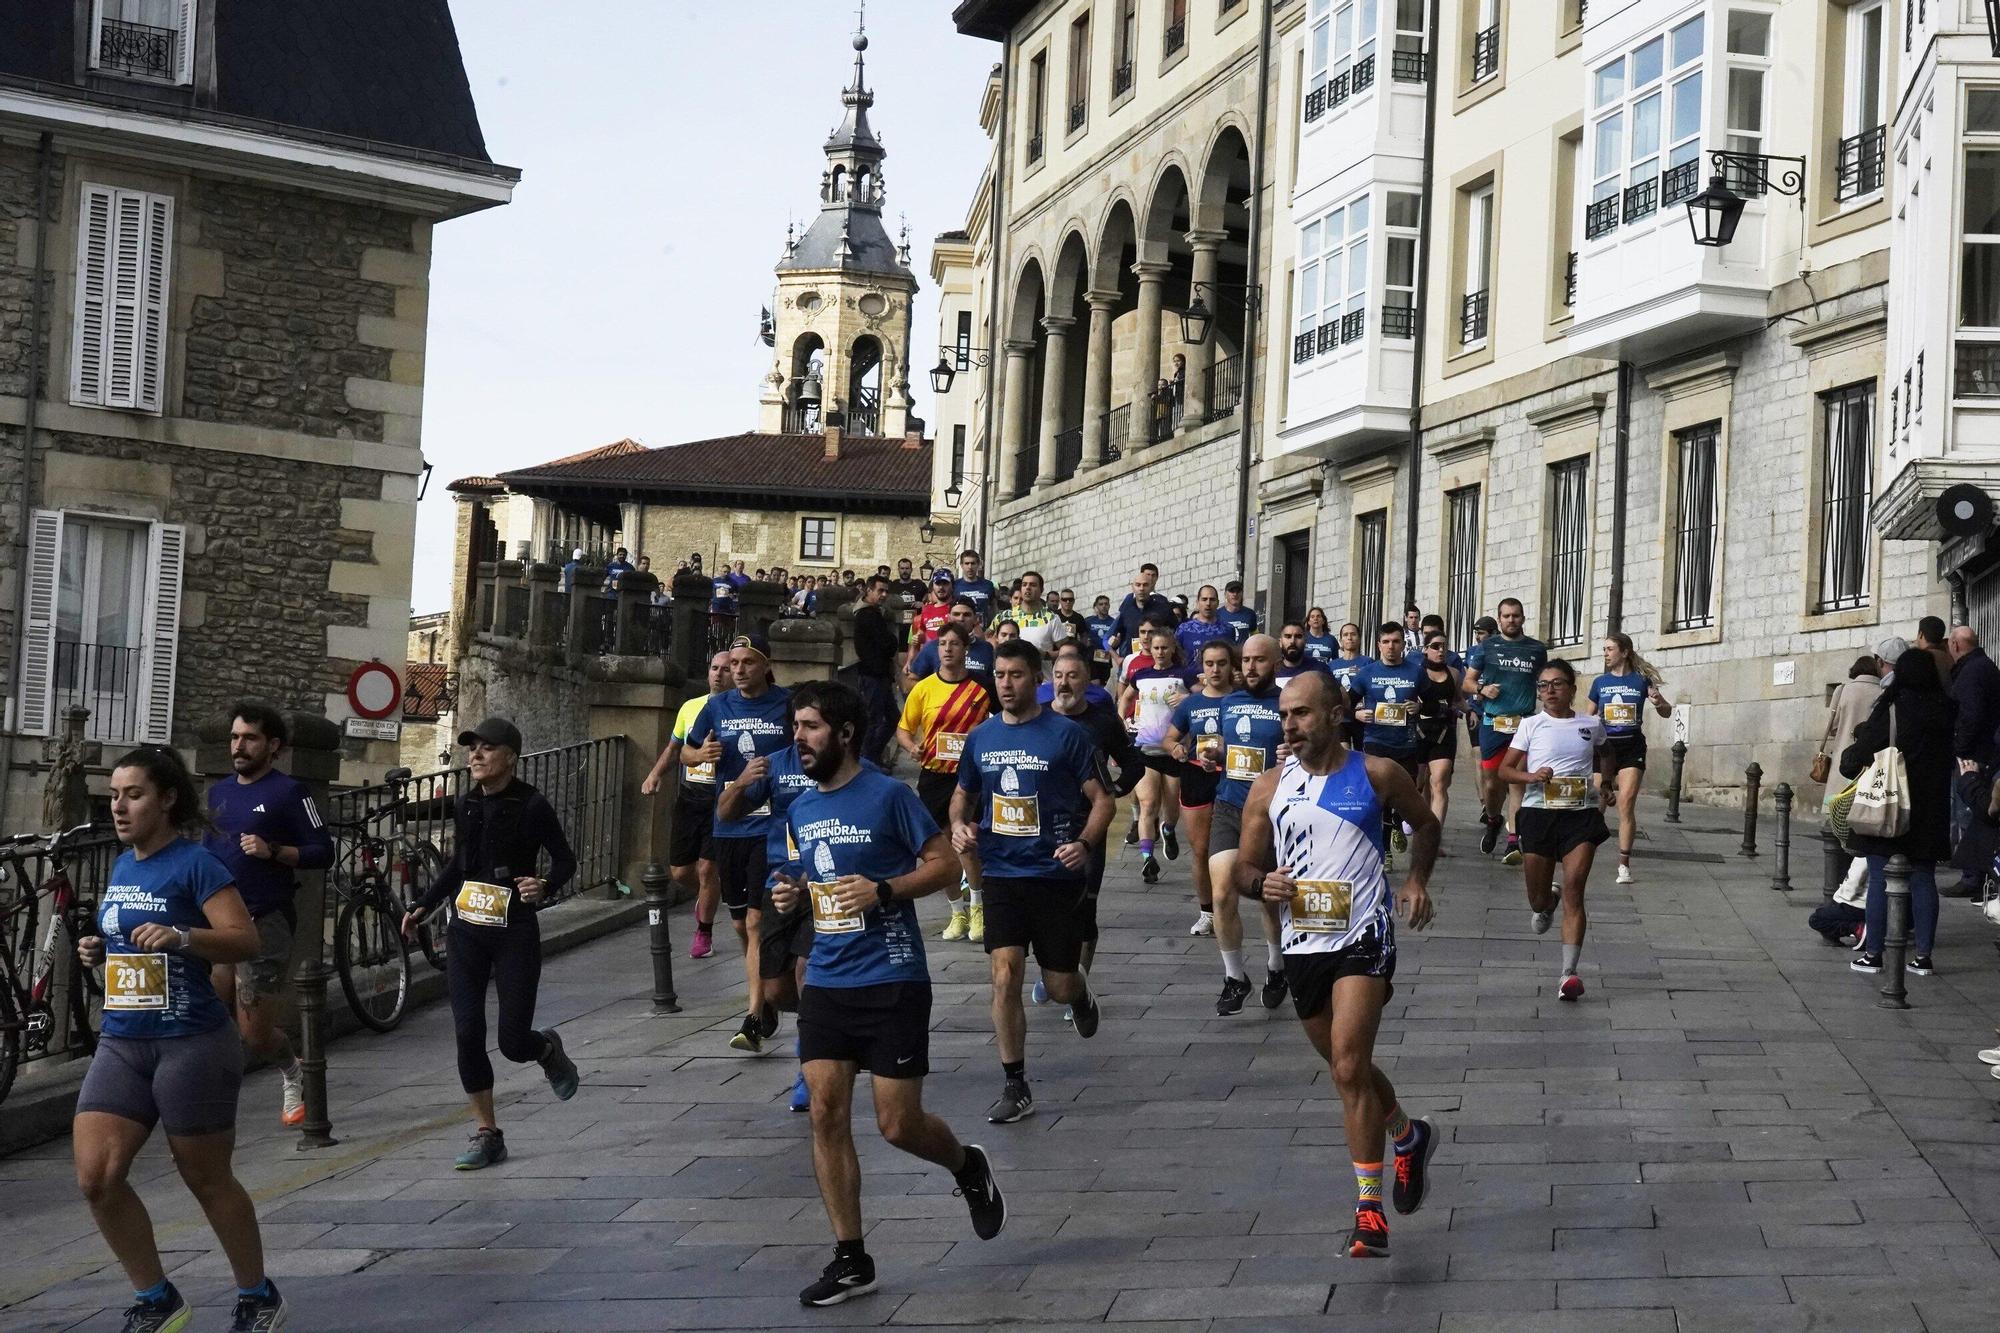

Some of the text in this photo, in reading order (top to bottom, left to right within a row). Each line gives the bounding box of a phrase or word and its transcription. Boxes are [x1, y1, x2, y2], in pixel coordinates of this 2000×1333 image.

[990, 756, 1038, 765] ALMENDRA
[1235, 754, 1251, 768] 181
[1560, 784, 1572, 796] 27
[1002, 807, 1024, 821] 404
[804, 818, 840, 831] CONQUISTA
[805, 825, 858, 842] ALMENDRA
[830, 835, 871, 844] KONKISTA
[122, 902, 167, 912] KONKISTA
[468, 893, 495, 910] 552
[818, 894, 842, 914] 192
[1303, 892, 1332, 913] 135
[117, 968, 146, 989] 231
